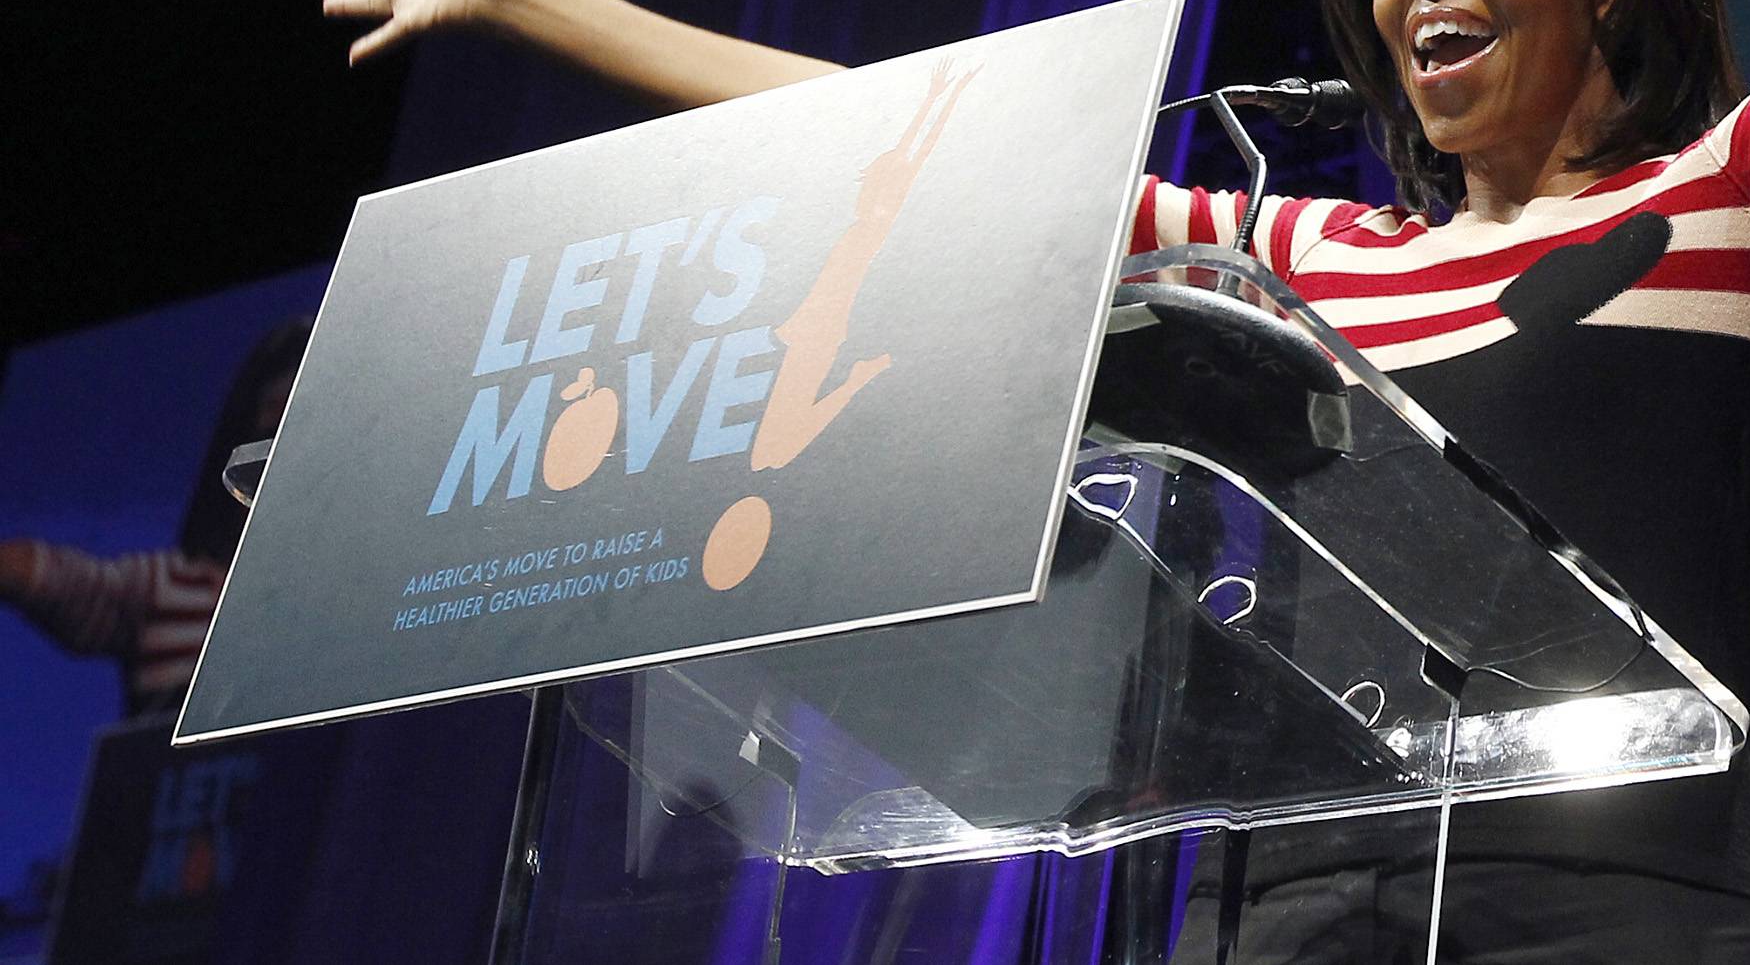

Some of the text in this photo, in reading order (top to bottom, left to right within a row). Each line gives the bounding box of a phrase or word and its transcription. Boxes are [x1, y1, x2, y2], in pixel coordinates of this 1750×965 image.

[471, 194, 784, 377] LET'S
[392, 556, 691, 632] HEALTHIER GENERATION OF KIDS
[403, 527, 664, 597] AMERICA'S MOVE TO RAISE A
